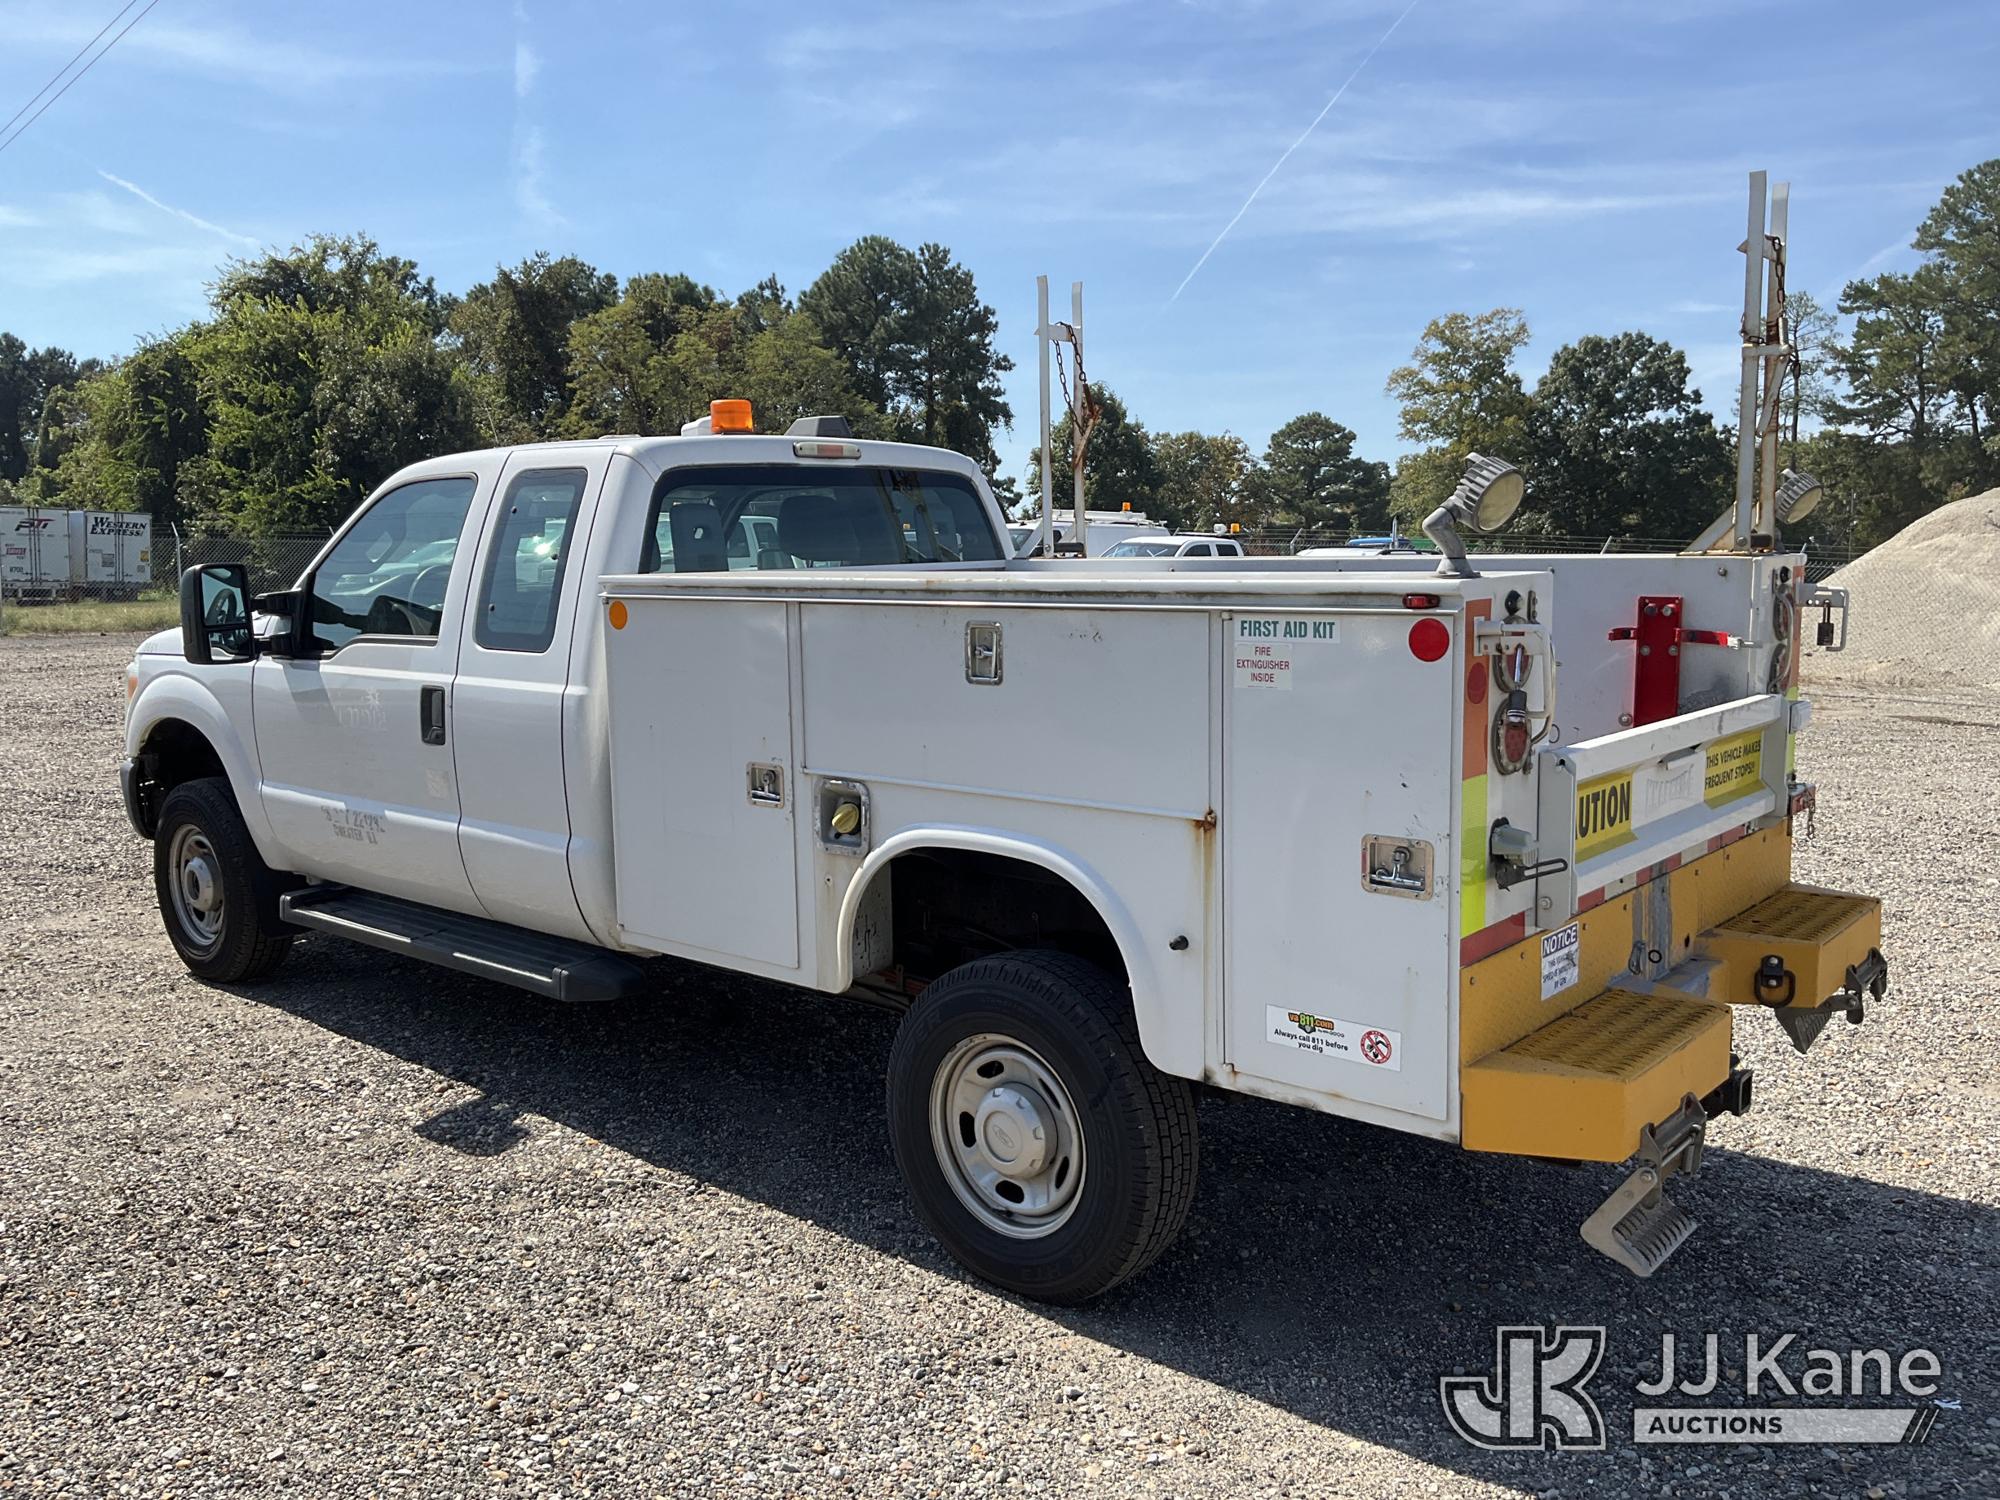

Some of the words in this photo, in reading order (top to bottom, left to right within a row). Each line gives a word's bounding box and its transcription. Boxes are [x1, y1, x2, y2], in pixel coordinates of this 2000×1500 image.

[93, 516, 147, 530] WESTERN
[1240, 620, 1279, 637] FIRST
[1283, 621, 1307, 638] AID
[1313, 621, 1335, 639] KIT
[1254, 646, 1271, 656] FIRE
[1236, 659, 1290, 670] EXTINGUISHER
[1250, 673, 1274, 682] INSIDE
[1706, 752, 1719, 769] THIS
[1720, 745, 1742, 764] VEHICLE
[1743, 739, 1761, 757] MAKES
[1704, 768, 1733, 790] FREQUENT
[1575, 781, 1631, 840] UTION
[1543, 926, 1577, 955] NOTICE
[1274, 1029, 1298, 1040] Always
[1298, 1034, 1310, 1043] call
[1311, 1036, 1324, 1046] 811
[1325, 1039, 1349, 1051] before
[1311, 1044, 1324, 1054] dig
